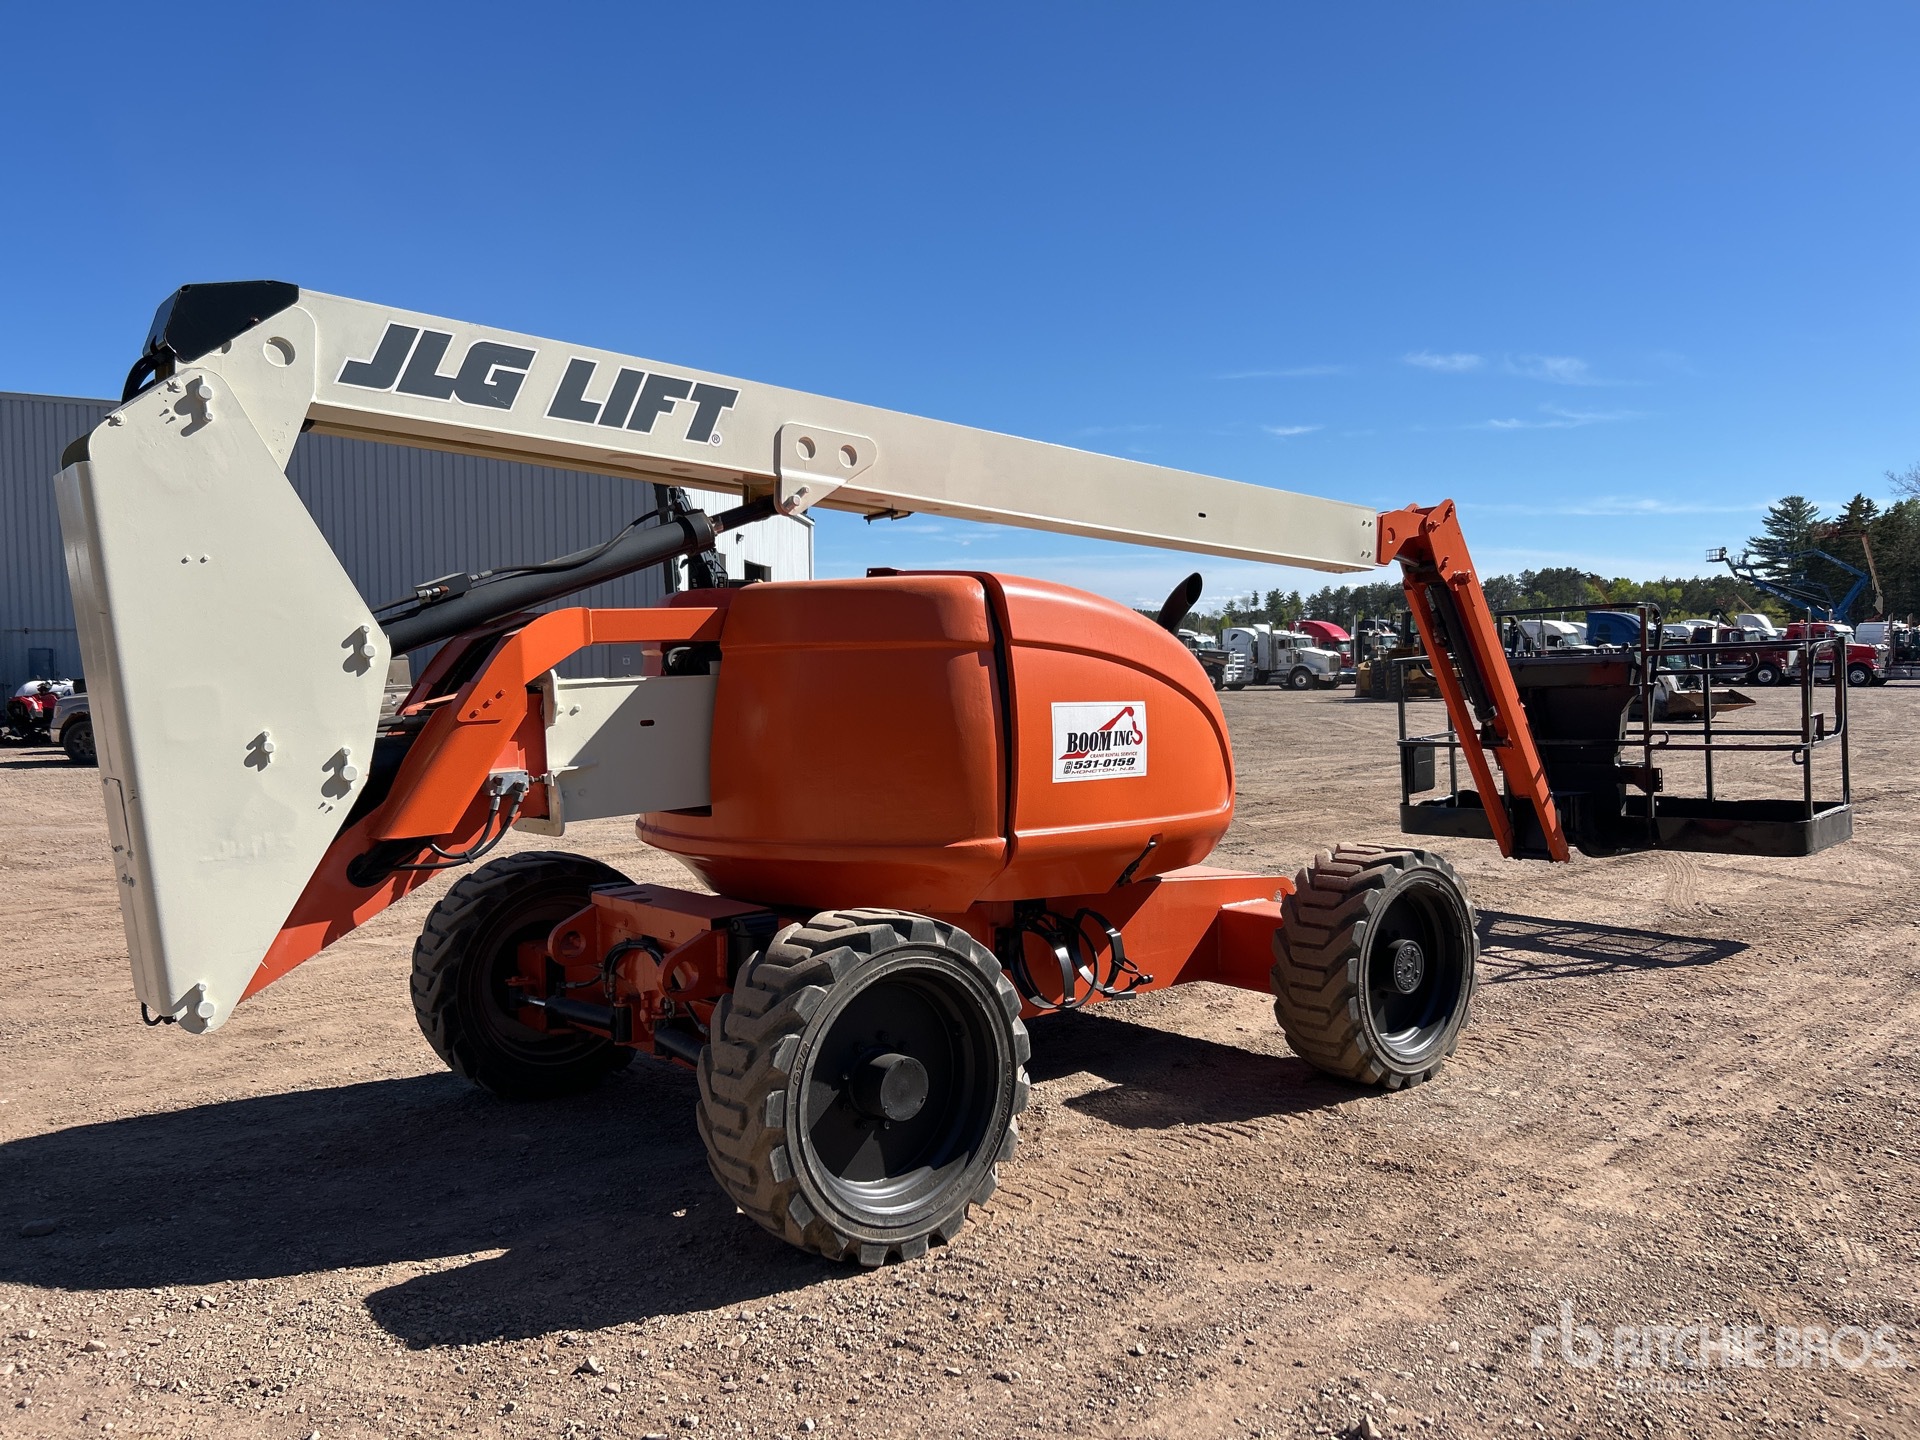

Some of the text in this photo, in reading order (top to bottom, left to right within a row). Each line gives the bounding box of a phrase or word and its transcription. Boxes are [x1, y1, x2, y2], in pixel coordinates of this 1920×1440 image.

[335, 321, 538, 411] JLG
[1066, 730, 1132, 753] BOOM INC
[1073, 757, 1136, 770] 531-0159
[793, 1041, 810, 1086] OTR
[982, 1061, 1014, 1167] OUTRIGGER
